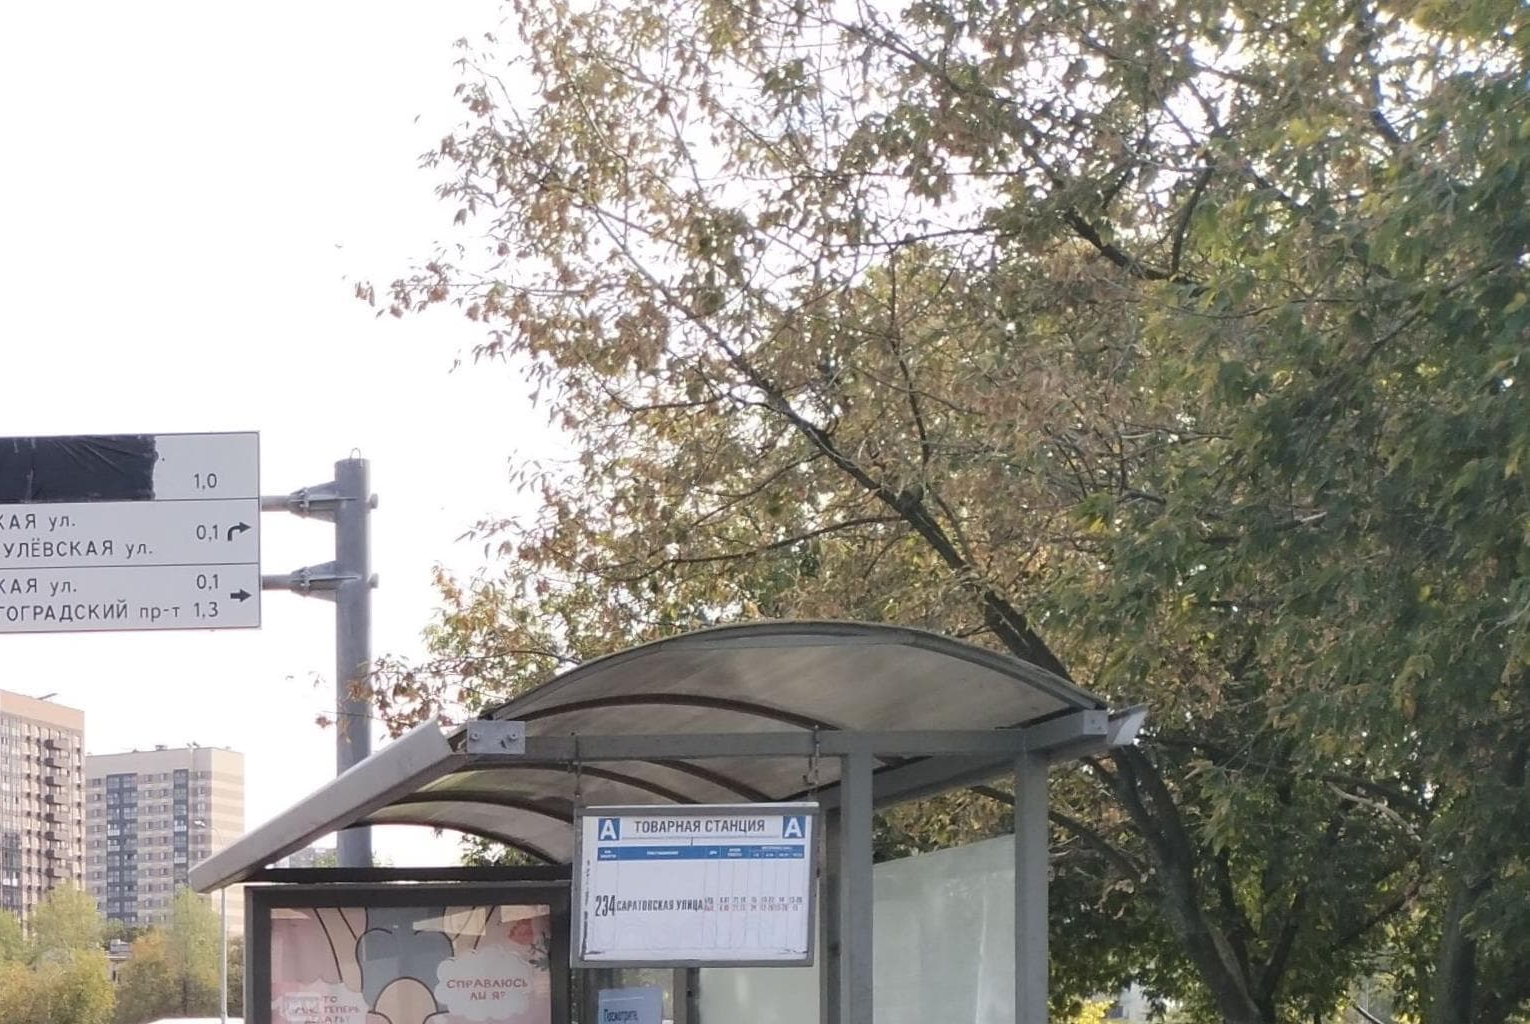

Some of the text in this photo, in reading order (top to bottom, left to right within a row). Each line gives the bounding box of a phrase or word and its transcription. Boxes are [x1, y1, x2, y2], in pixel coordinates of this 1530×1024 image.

[194, 473, 218, 490] 1,0
[49, 515, 76, 532] ул.
[196, 524, 219, 541] 0,1
[125, 543, 154, 560] ул.
[50, 581, 78, 597] ул.
[196, 573, 219, 590] 0,1
[139, 606, 180, 623] пр-т
[634, 820, 701, 834] ТОВАРНАЯ
[705, 818, 766, 835] СТАНЦИЯ
[595, 894, 616, 917] 234
[616, 899, 674, 912] САРАТОВСКАЯ
[676, 898, 704, 913] УЛИЦА
